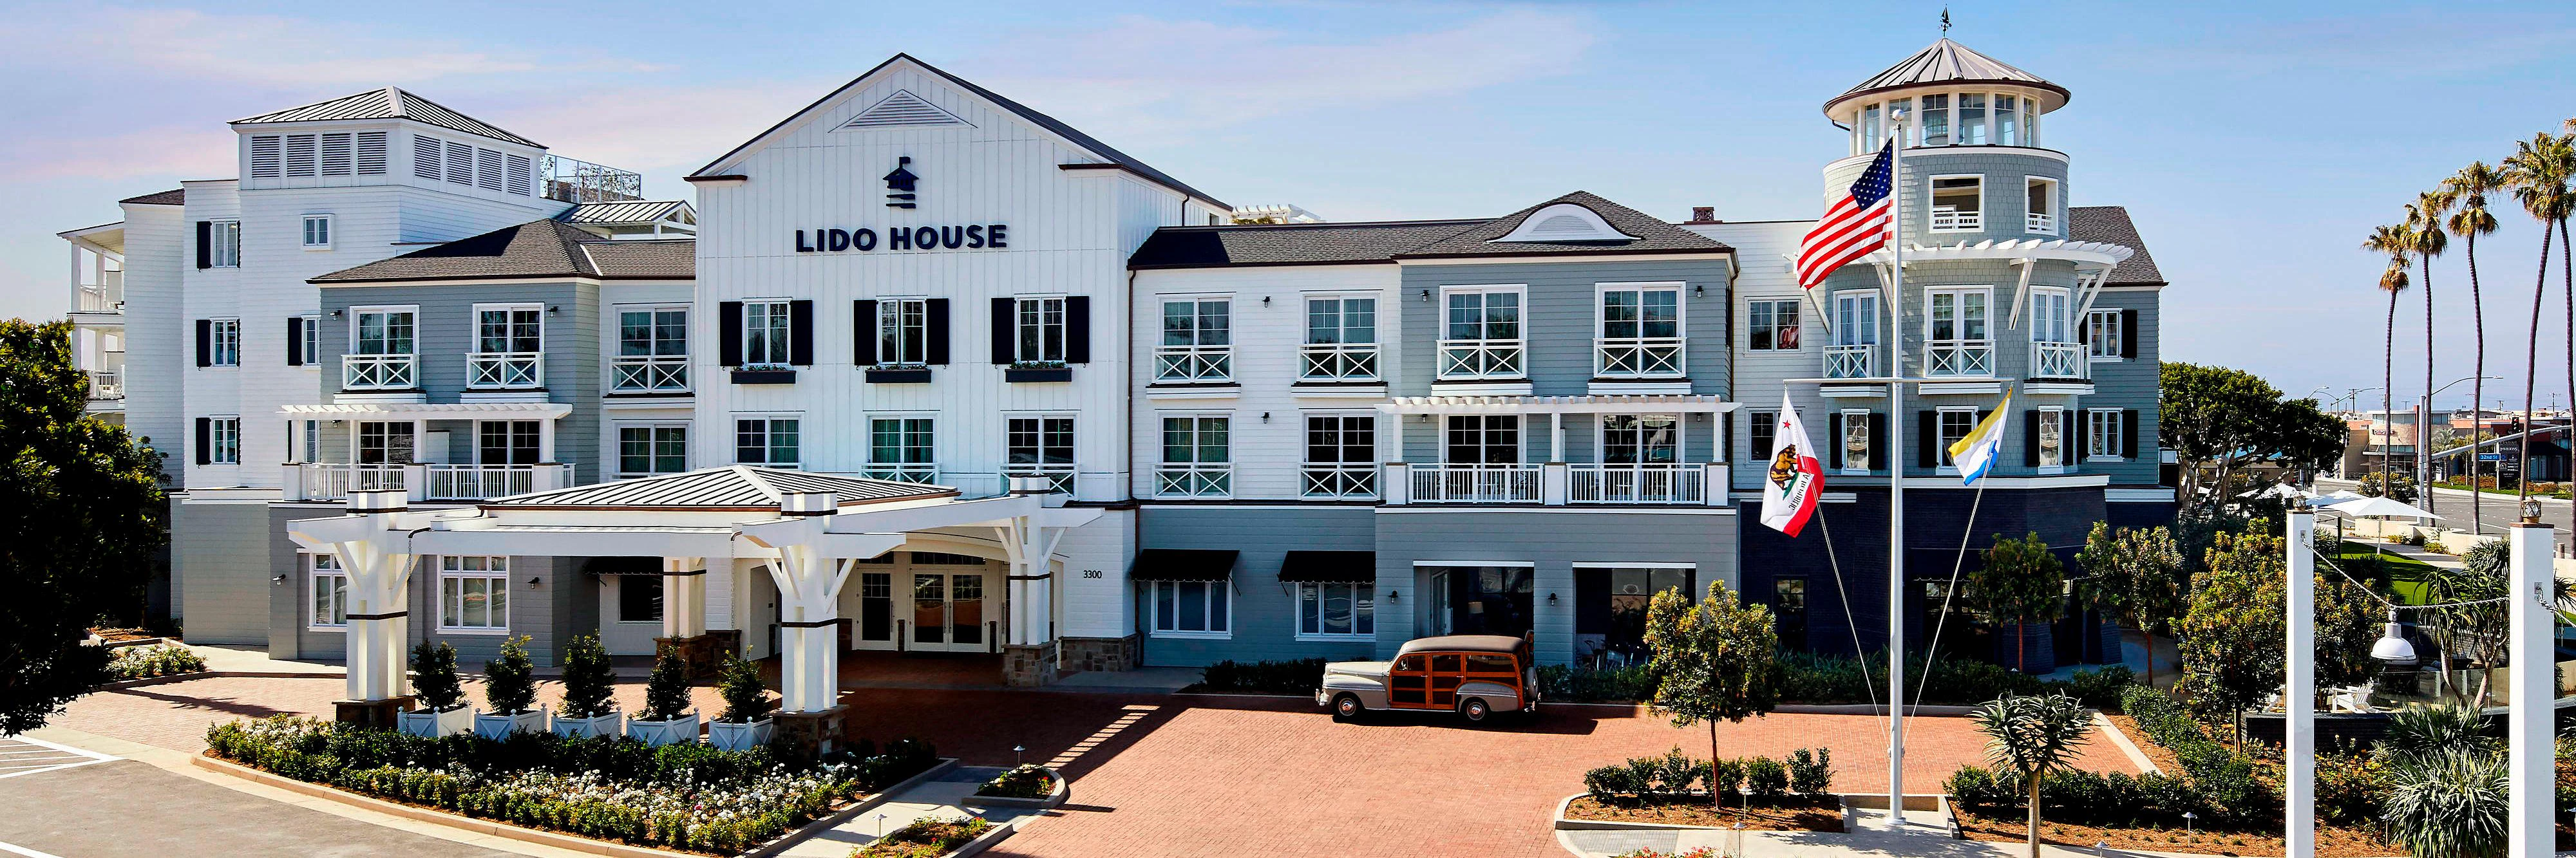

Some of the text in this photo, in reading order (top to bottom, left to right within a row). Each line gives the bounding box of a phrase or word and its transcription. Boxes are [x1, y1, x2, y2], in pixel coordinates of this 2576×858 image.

[795, 224, 1007, 253] LIDO HOUSE
[1083, 570, 1103, 579] 3300
